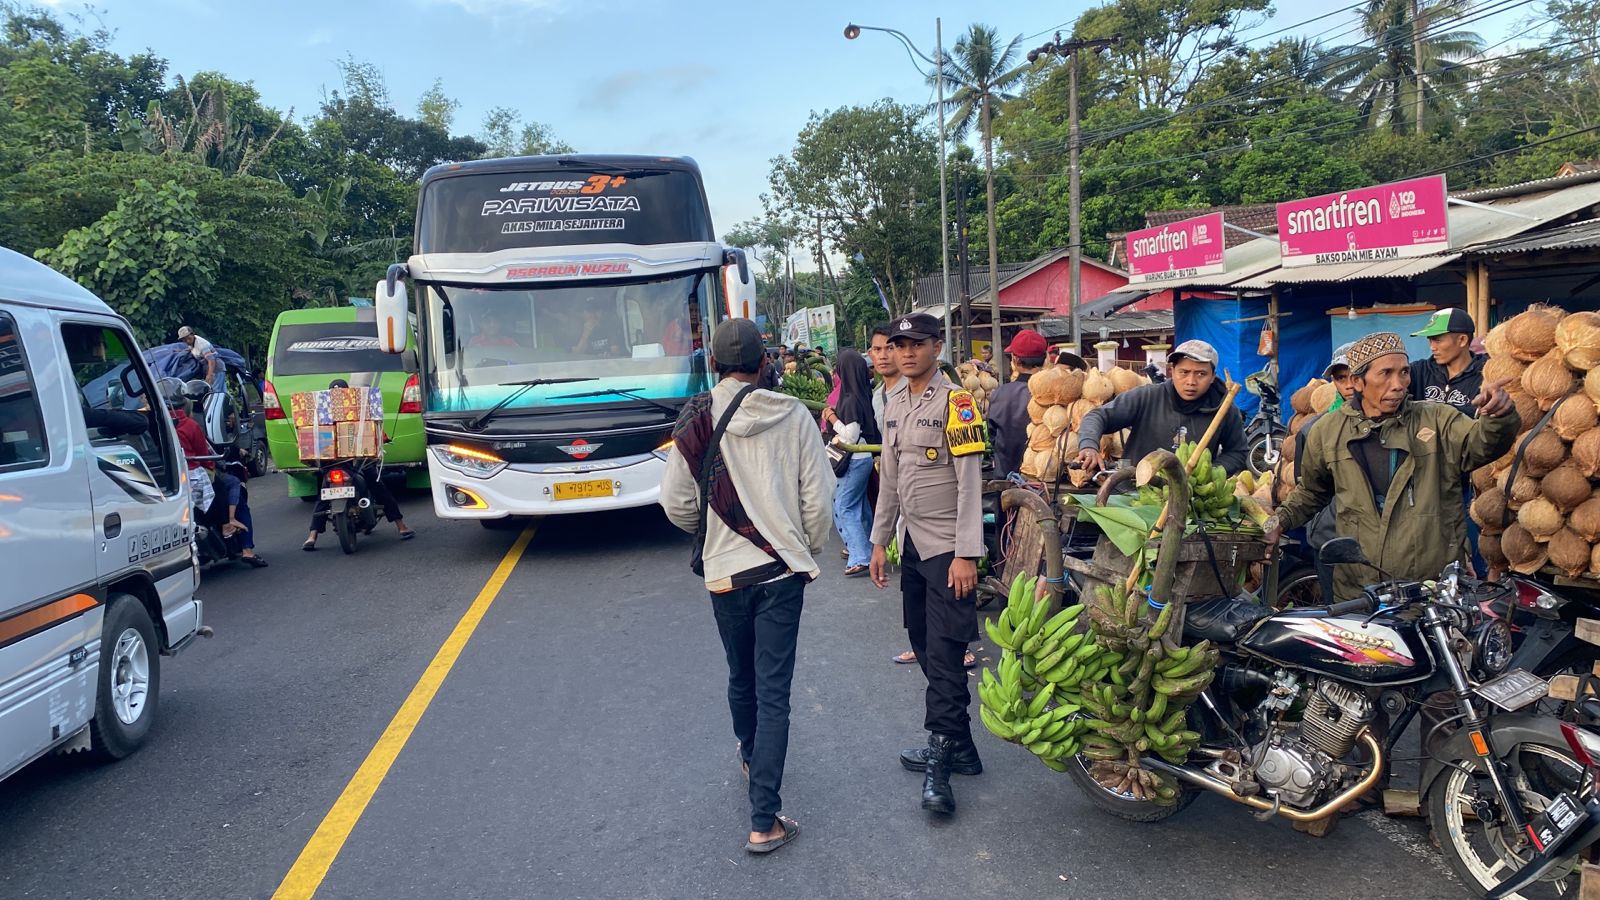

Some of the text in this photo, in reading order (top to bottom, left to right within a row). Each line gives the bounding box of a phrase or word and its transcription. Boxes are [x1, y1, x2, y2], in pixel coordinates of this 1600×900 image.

[500, 175, 627, 194] JETBUS 3+
[481, 196, 640, 215] PARIWISATA
[1398, 190, 1416, 205] 100
[1287, 193, 1382, 235] smartfren
[501, 218, 625, 234] AKAS MILA SEJAHTERA
[1133, 226, 1188, 258] smartfren
[1315, 247, 1399, 263] BAKSO DAN MIE AYAM
[916, 418, 943, 428] POLRI
[555, 480, 611, 495] N 7975 US
